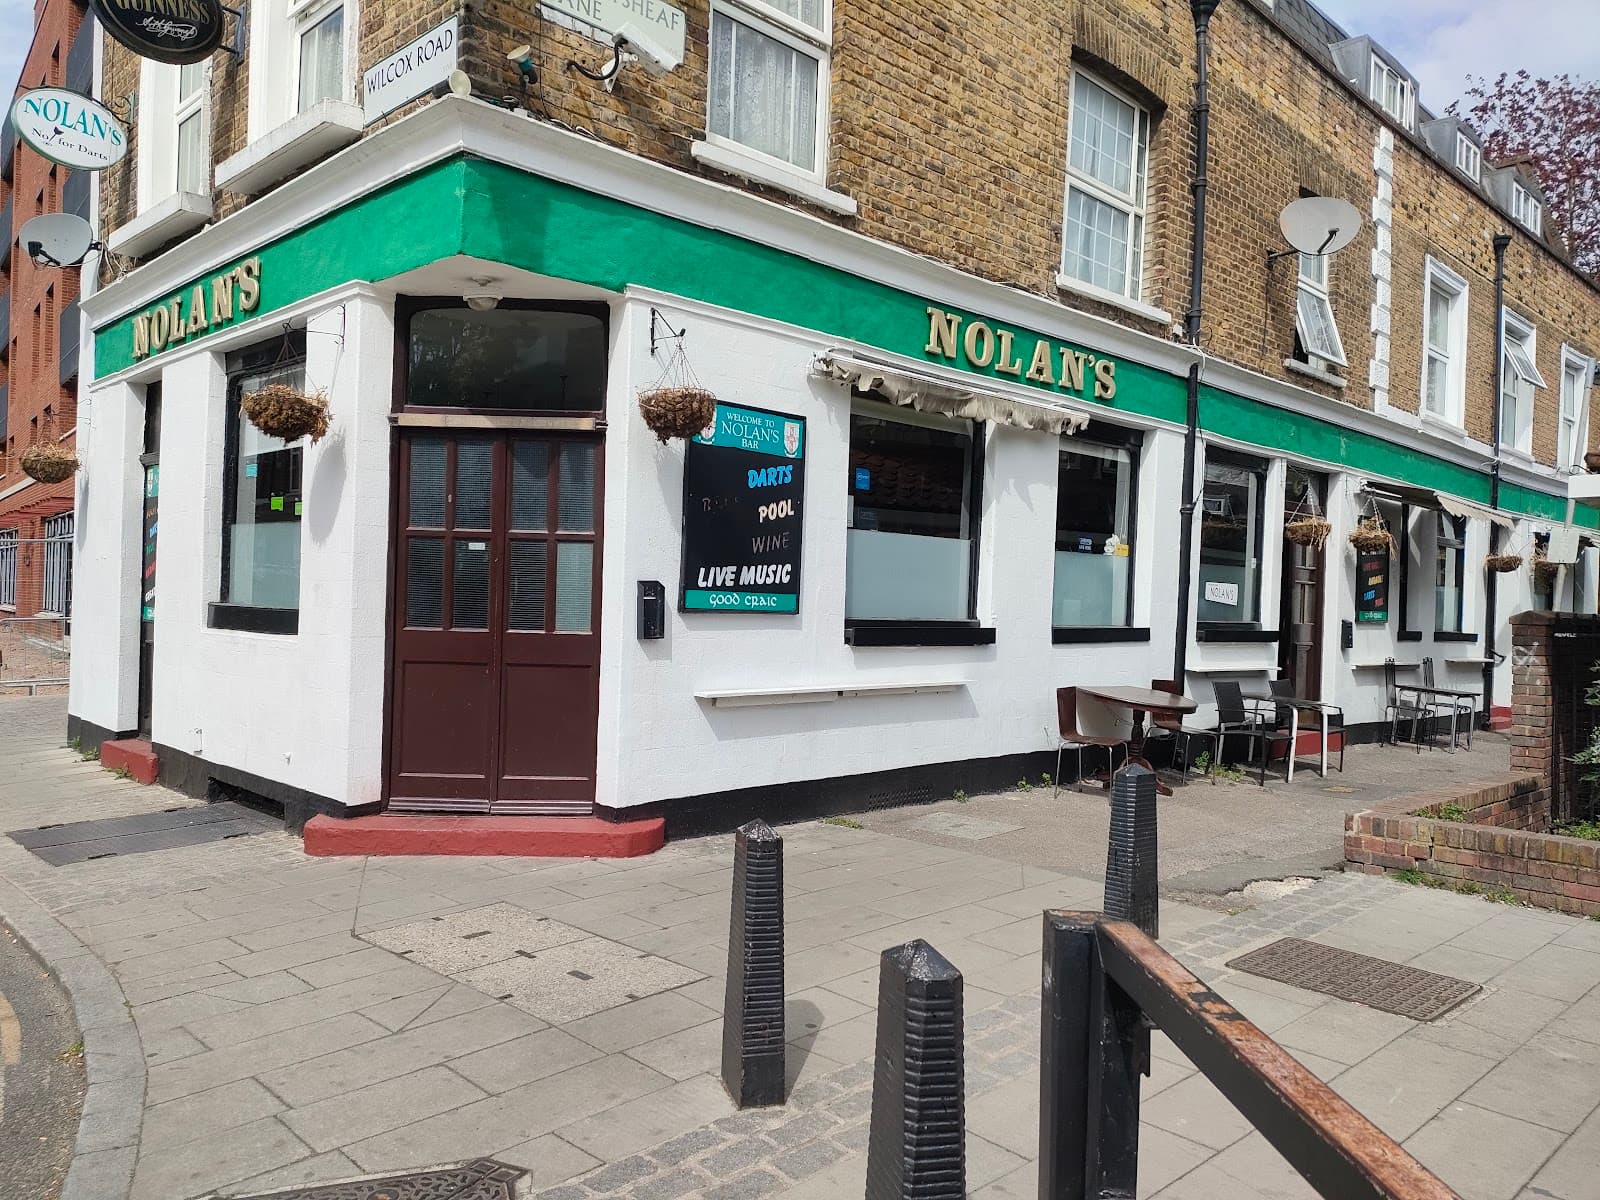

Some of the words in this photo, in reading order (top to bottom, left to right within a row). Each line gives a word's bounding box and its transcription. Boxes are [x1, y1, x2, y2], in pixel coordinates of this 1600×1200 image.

[366, 51, 413, 95] WILCOX
[417, 29, 453, 67] ROAD
[23, 96, 123, 147] NOLAN'S
[58, 137, 75, 149] for
[78, 144, 108, 160] Darts
[132, 255, 260, 358] NOLAN'S
[924, 306, 1117, 400] NOLAN'S
[721, 420, 780, 444] NOLAN'S
[726, 411, 762, 426] WELCOME
[765, 419, 775, 428] TO
[741, 438, 760, 449] BAR
[747, 464, 793, 489] DARTS
[758, 498, 795, 524] POOL
[752, 531, 791, 554] WINE
[697, 565, 737, 588] LIVE
[739, 563, 792, 586] MUSIC
